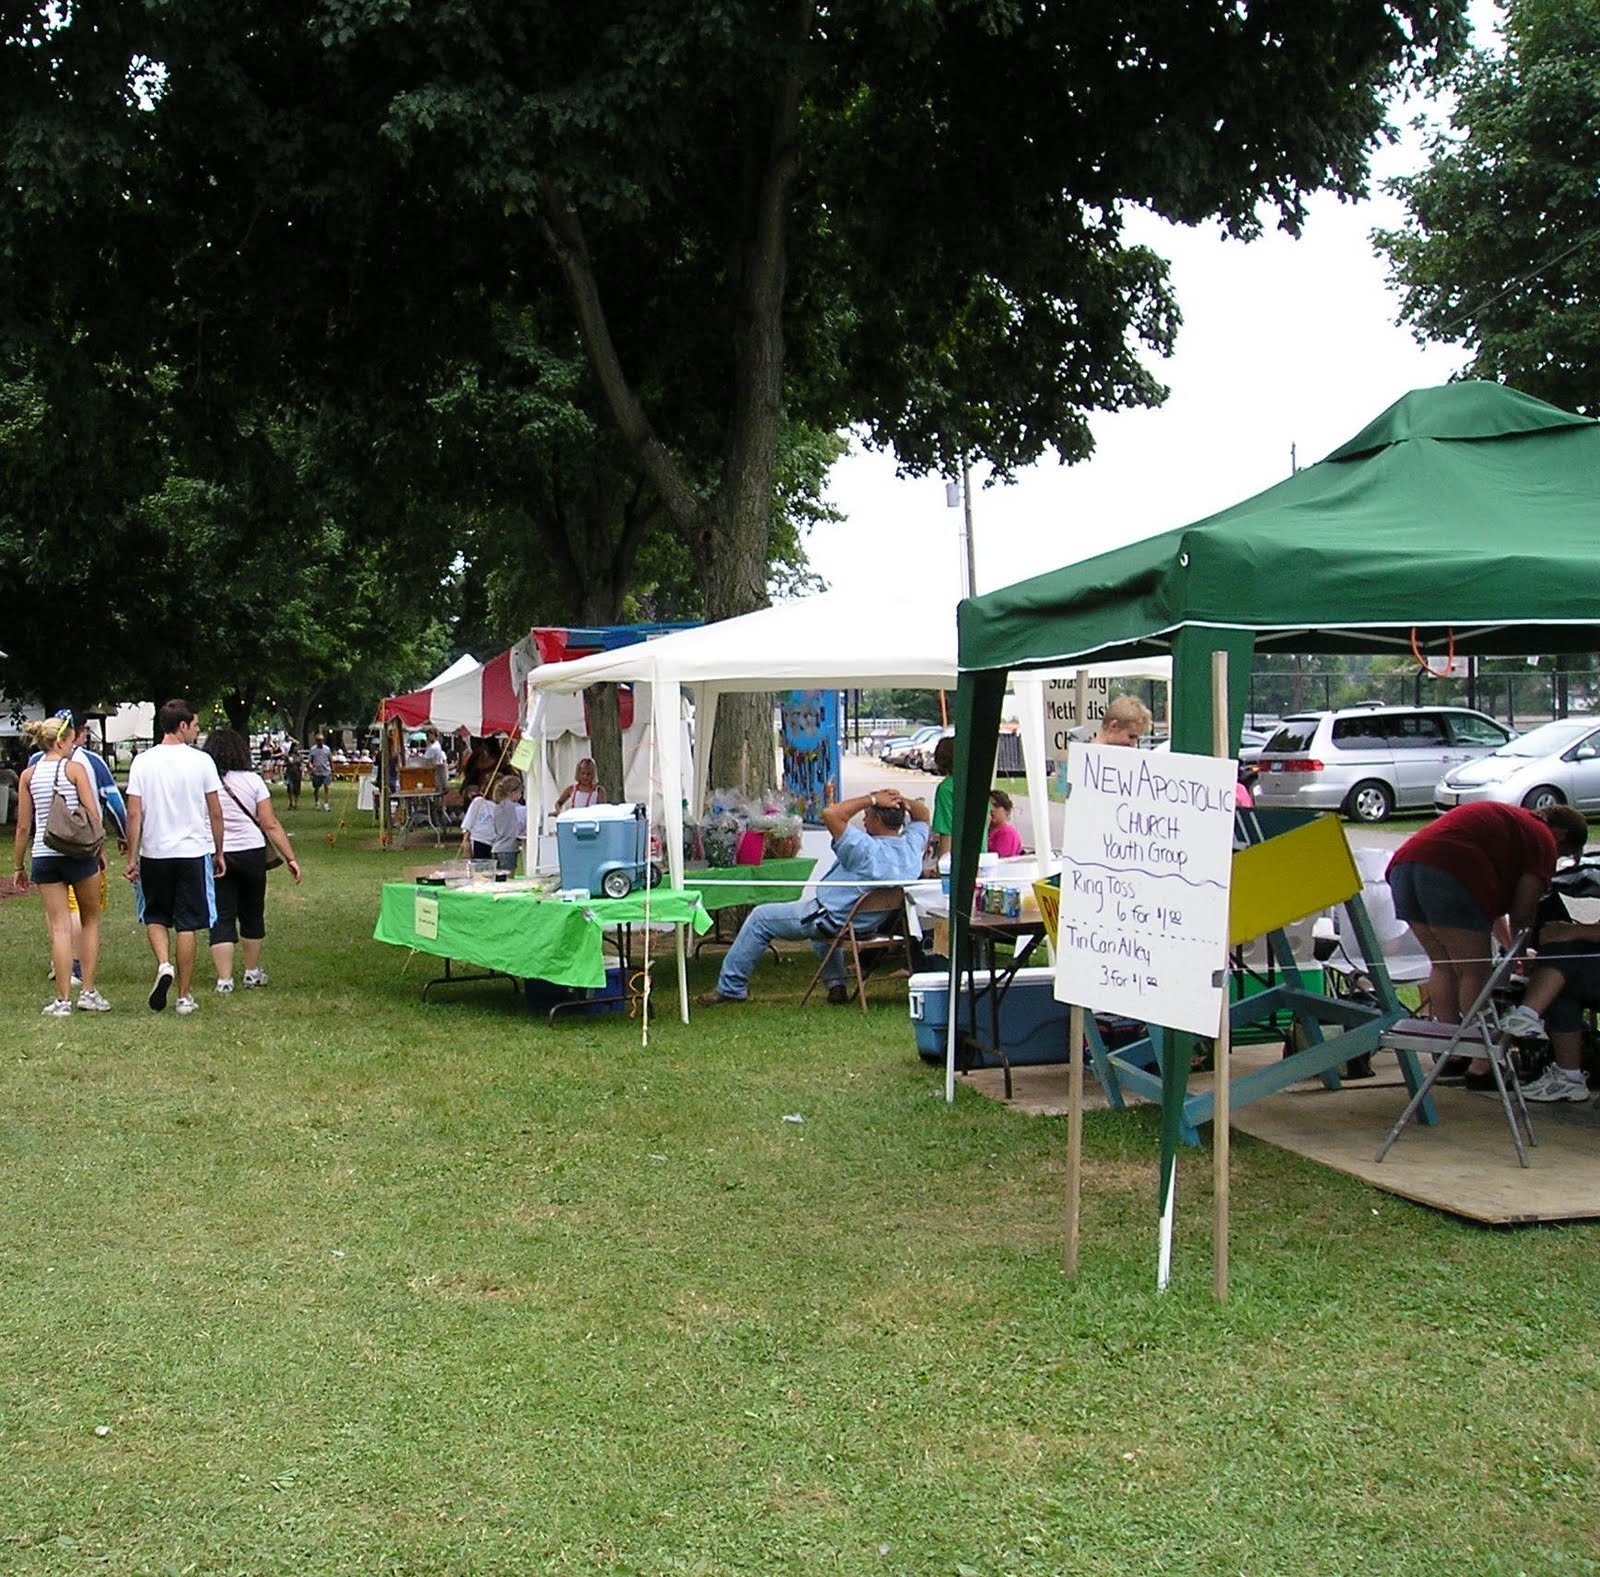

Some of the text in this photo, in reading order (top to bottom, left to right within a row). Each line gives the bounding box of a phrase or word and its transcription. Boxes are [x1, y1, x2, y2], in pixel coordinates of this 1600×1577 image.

[1046, 700, 1108, 721] Methdis
[1084, 752, 1232, 813] NEW APOSTOLIC
[1116, 802, 1181, 839] CHURCH
[1103, 833, 1188, 872] Youth Group
[1072, 870, 1136, 913] Ring Toss
[1116, 901, 1126, 921] 6
[1066, 925, 1151, 967] Tin Can Alley
[1099, 965, 1108, 985] 3
